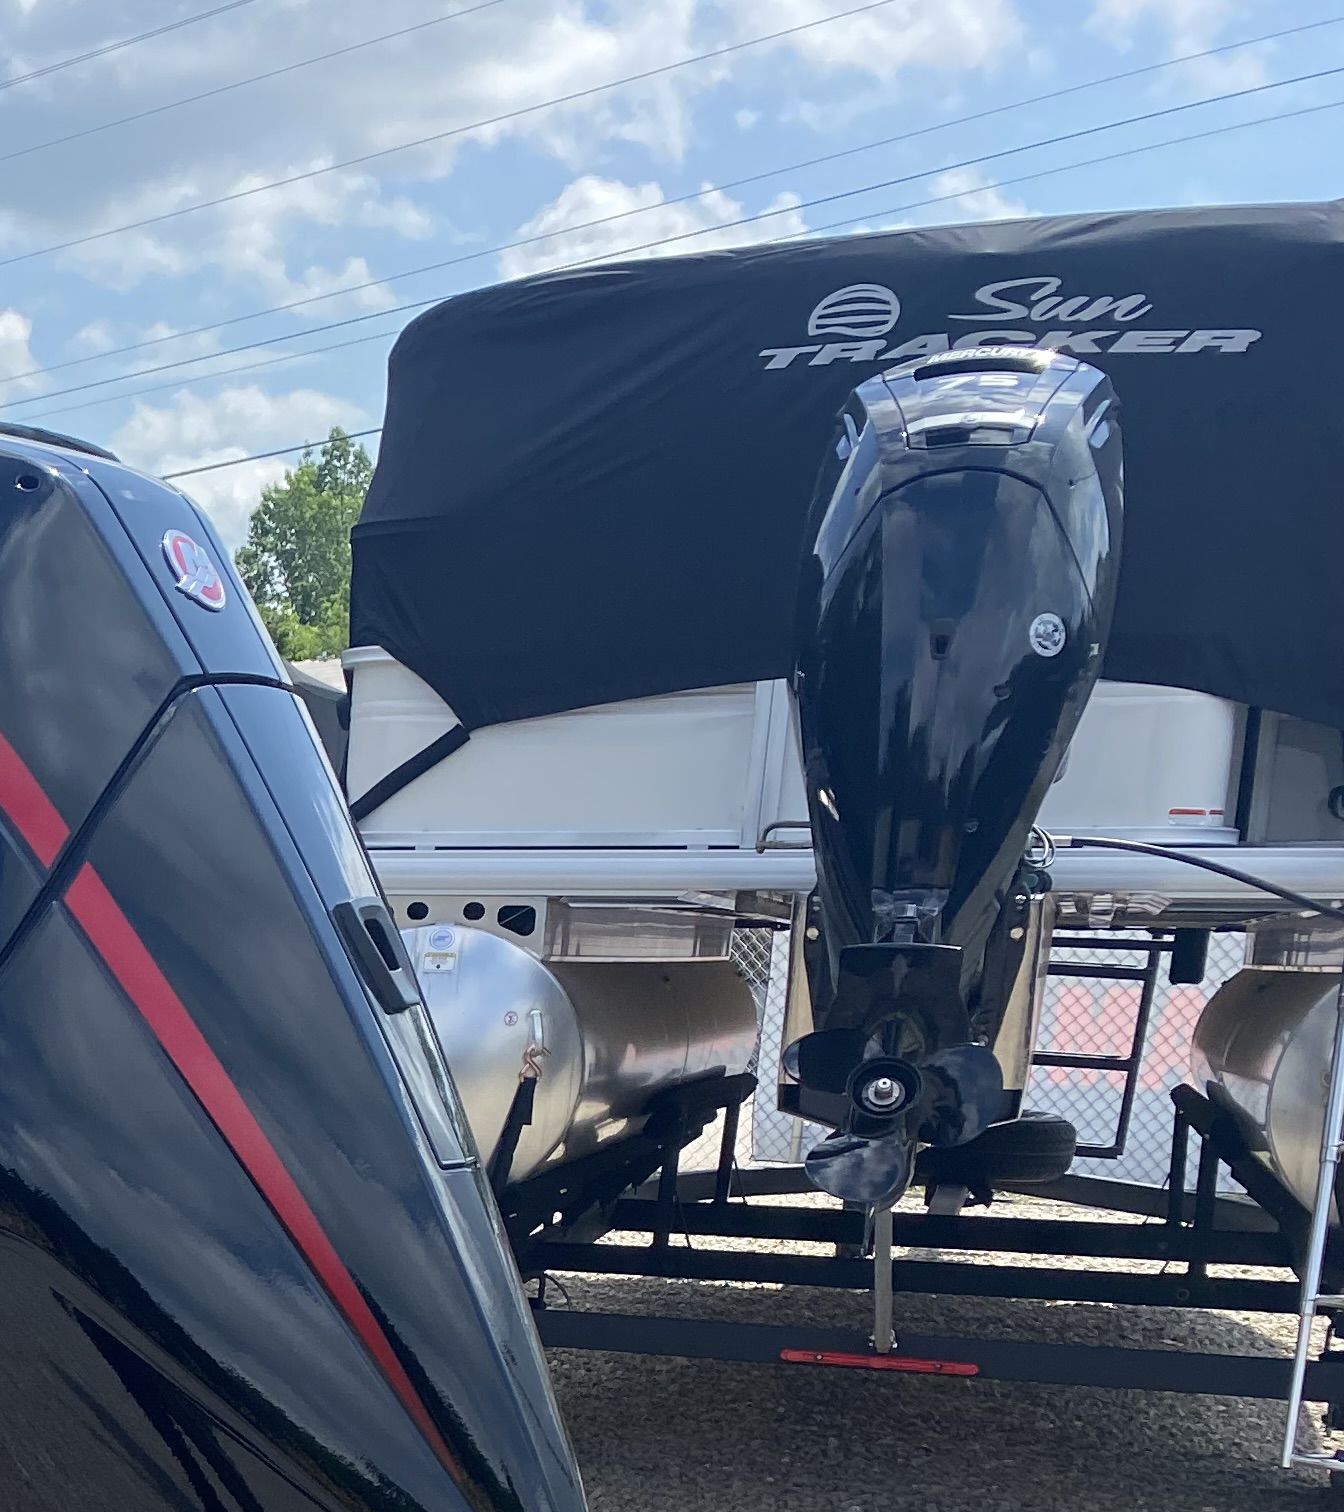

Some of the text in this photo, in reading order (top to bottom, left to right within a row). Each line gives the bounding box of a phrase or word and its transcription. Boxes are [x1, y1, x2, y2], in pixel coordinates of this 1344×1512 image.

[948, 276, 1153, 323] Sun
[758, 329, 1262, 370] TRACKER
[938, 375, 1019, 391] 75
